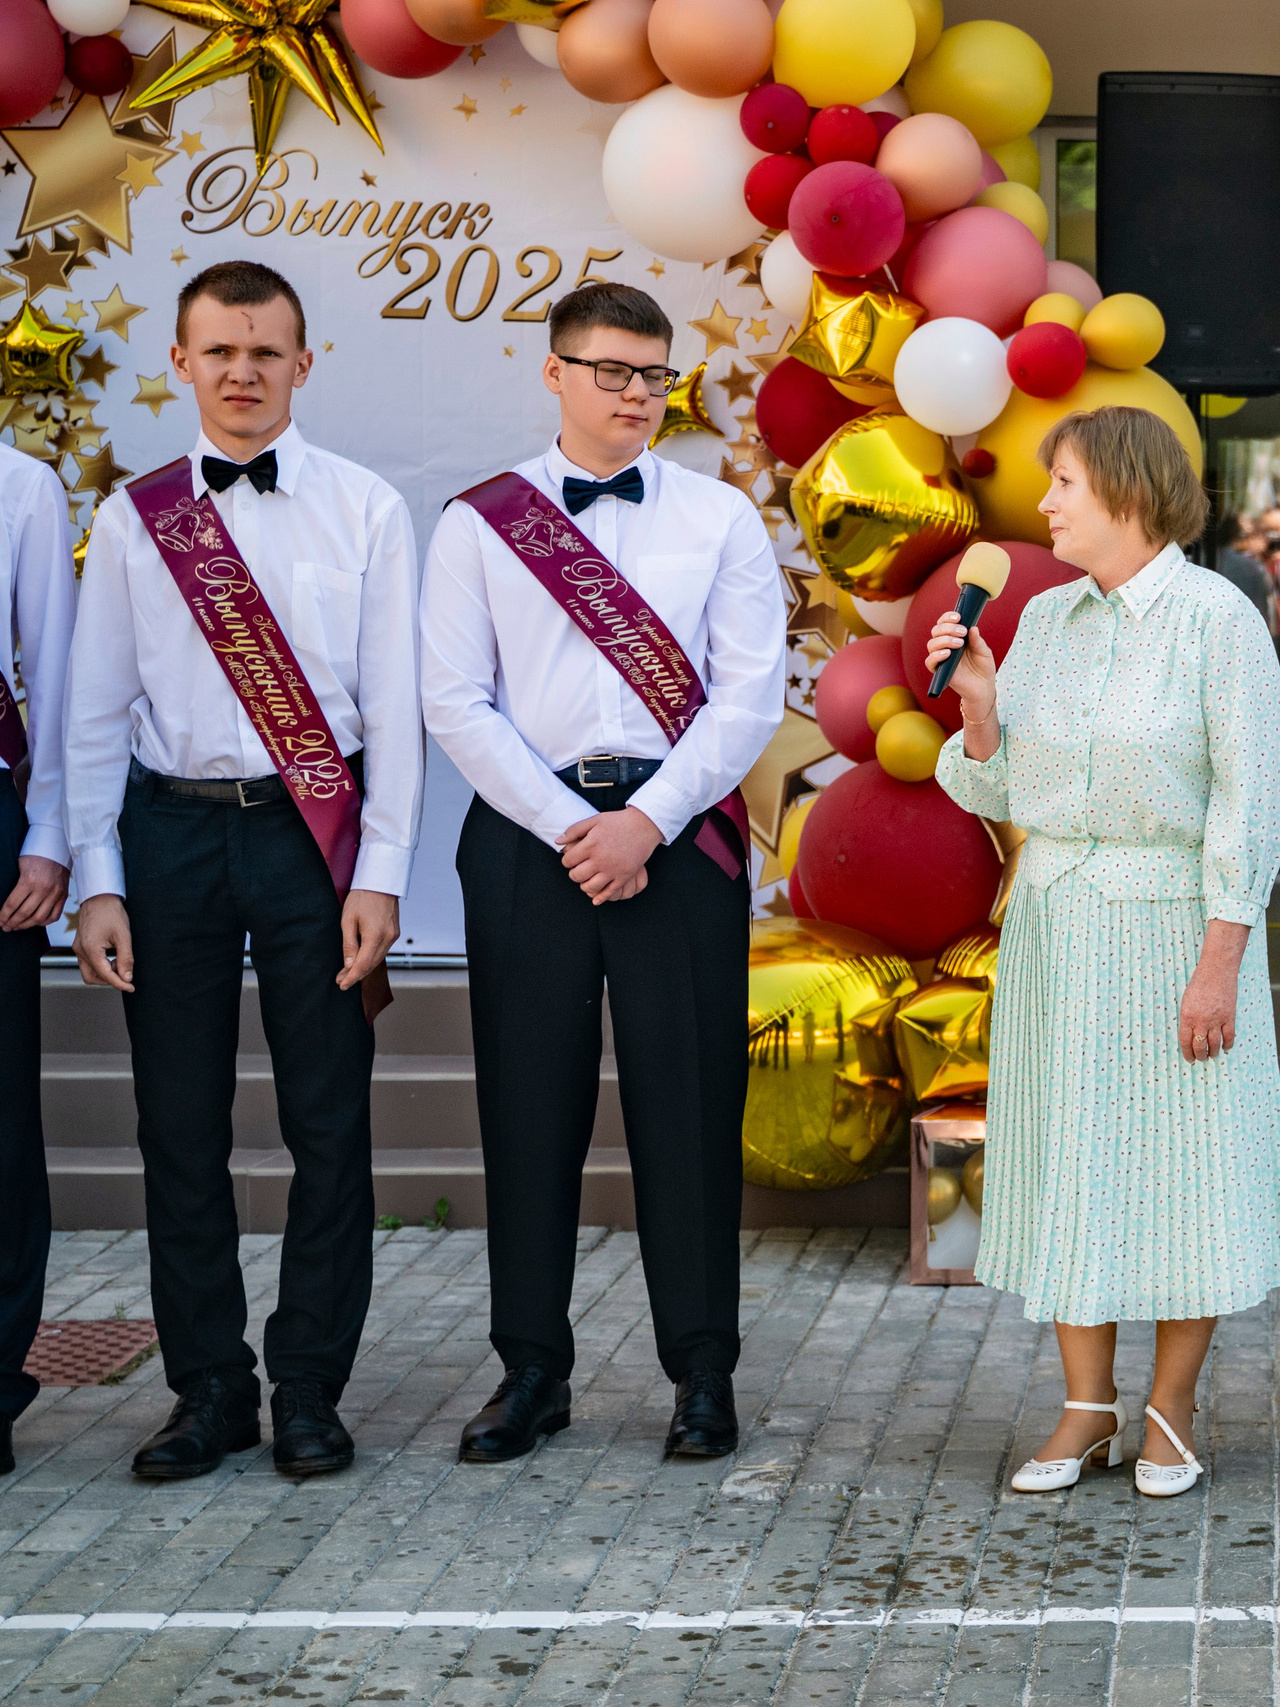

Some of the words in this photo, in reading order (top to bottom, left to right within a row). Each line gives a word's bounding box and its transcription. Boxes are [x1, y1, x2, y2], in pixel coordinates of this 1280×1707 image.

[181, 146, 493, 278] Выпуск
[192, 597, 205, 607] 11
[197, 608, 215, 631] класс
[566, 599, 580, 608] 11
[574, 608, 595, 629] класс
[561, 557, 687, 708] Выпускник
[195, 555, 298, 729] Выпускник
[282, 729, 353, 799] 2025
[662, 645, 692, 686] Тимур
[282, 671, 312, 717] Алексей
